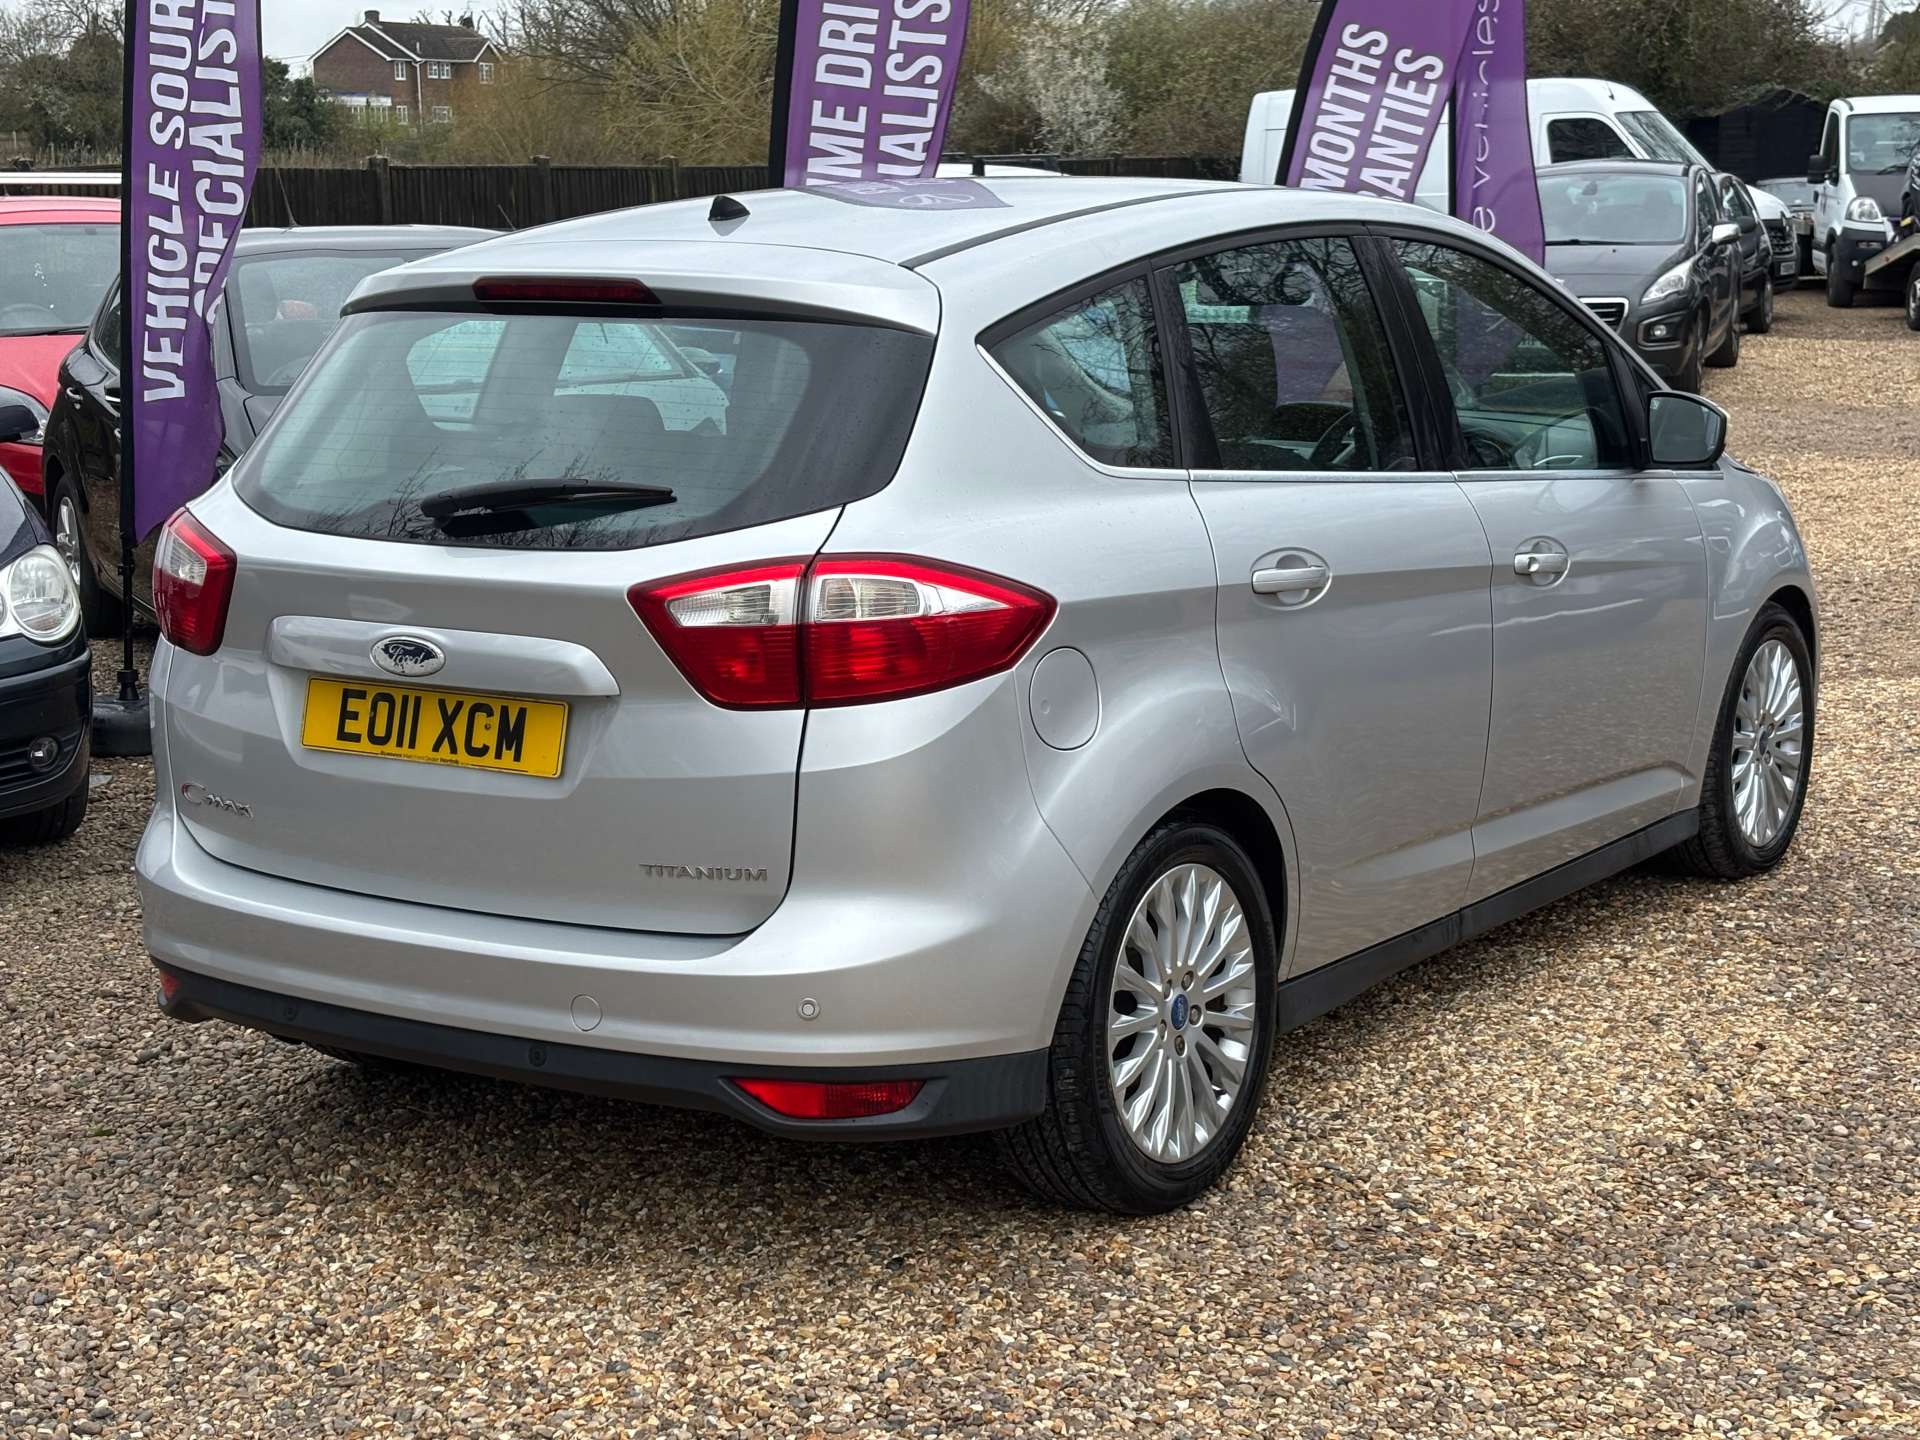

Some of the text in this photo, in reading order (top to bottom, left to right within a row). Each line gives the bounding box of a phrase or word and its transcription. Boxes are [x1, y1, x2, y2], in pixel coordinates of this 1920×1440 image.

[815, 3, 880, 89] DRI
[1300, 24, 1389, 191] MONTHS
[1356, 48, 1444, 202] ANTIES
[143, 0, 196, 402] VEHICLE SOUR
[336, 687, 528, 763] EO11 XCM
[639, 863, 769, 881] TITANIUM
